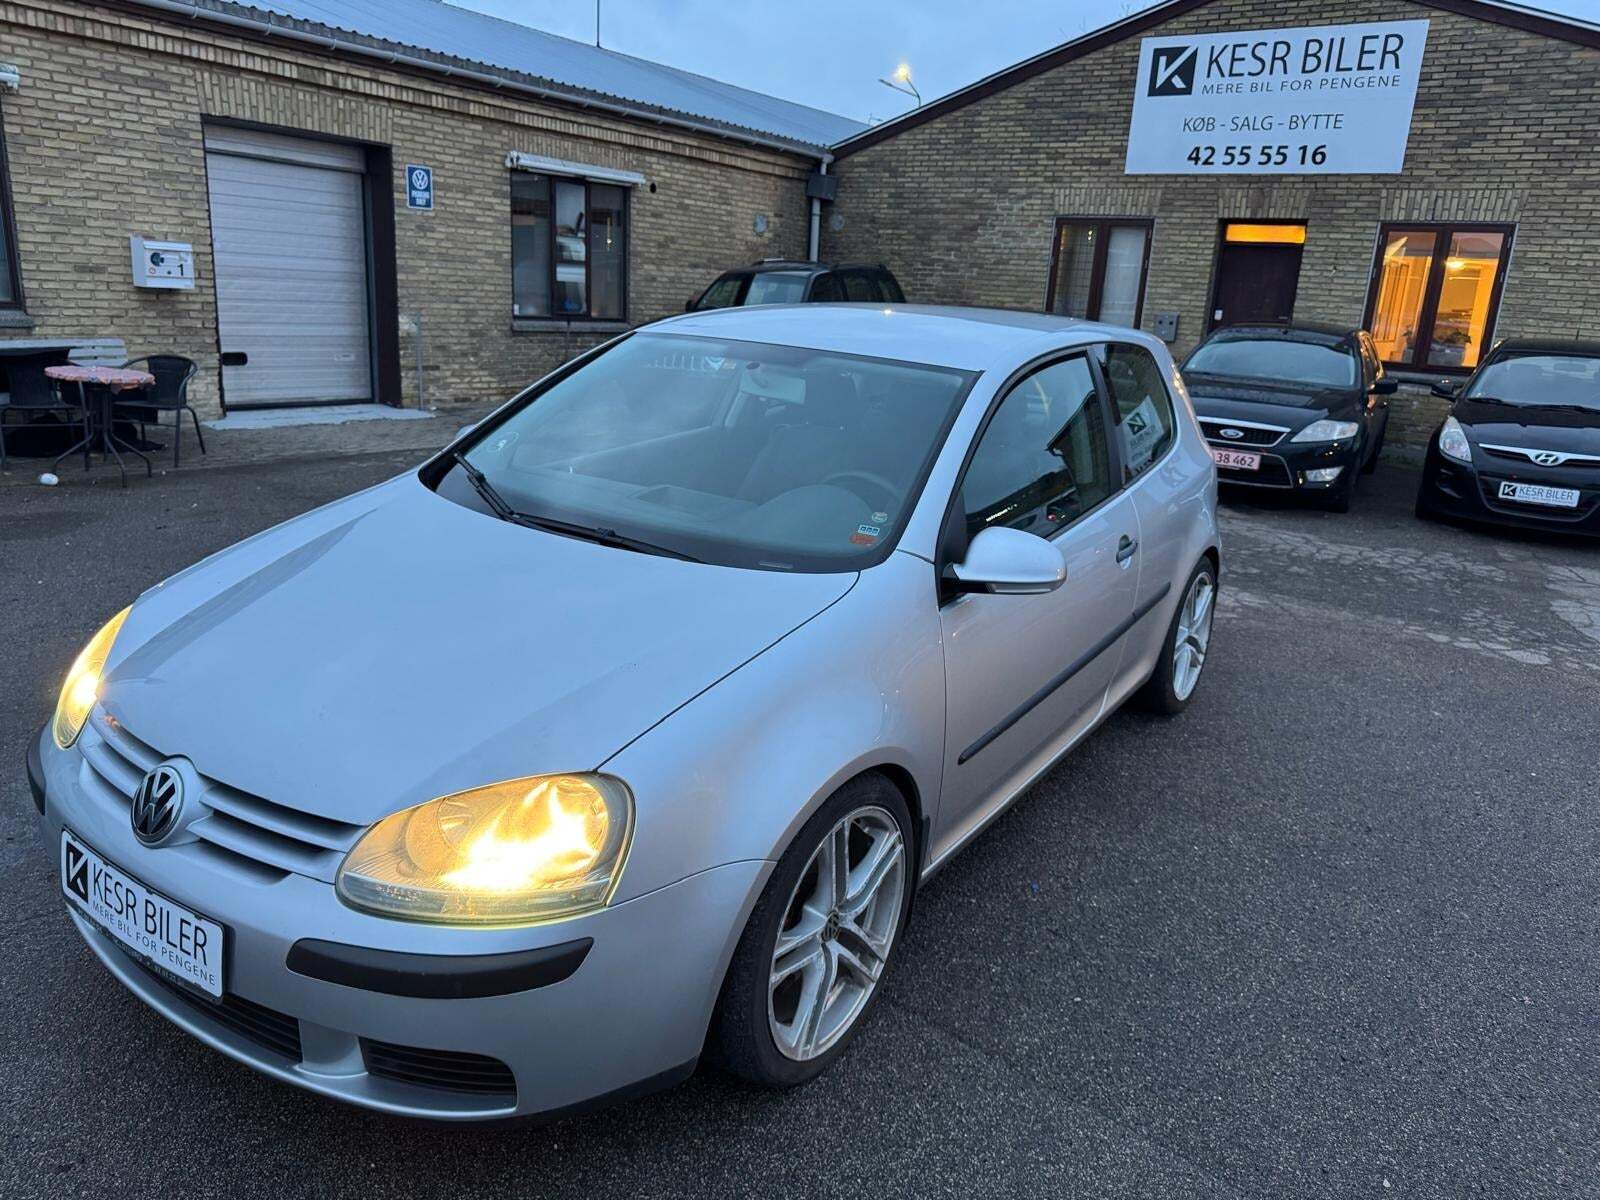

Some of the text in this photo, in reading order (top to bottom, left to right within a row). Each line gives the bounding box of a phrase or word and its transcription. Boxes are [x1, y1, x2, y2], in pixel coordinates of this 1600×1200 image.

[1206, 33, 1404, 78] KESR BILER
[1201, 75, 1401, 95] MERE BIL FOR PENGENE
[1183, 116, 1215, 133] KØB
[1229, 114, 1273, 132] SALG
[1288, 113, 1344, 130] BYTTE
[1187, 144, 1327, 166] 42 55 55 16
[177, 264, 184, 276] 1
[1215, 452, 1255, 467] 38 462
[1518, 486, 1543, 497] KESR
[1546, 490, 1574, 501] BILER
[93, 863, 208, 966] KESR BILER
[92, 900, 115, 926] MERE
[117, 919, 132, 937] BIL
[136, 932, 157, 952] FOR
[161, 946, 216, 986] PENGENE
